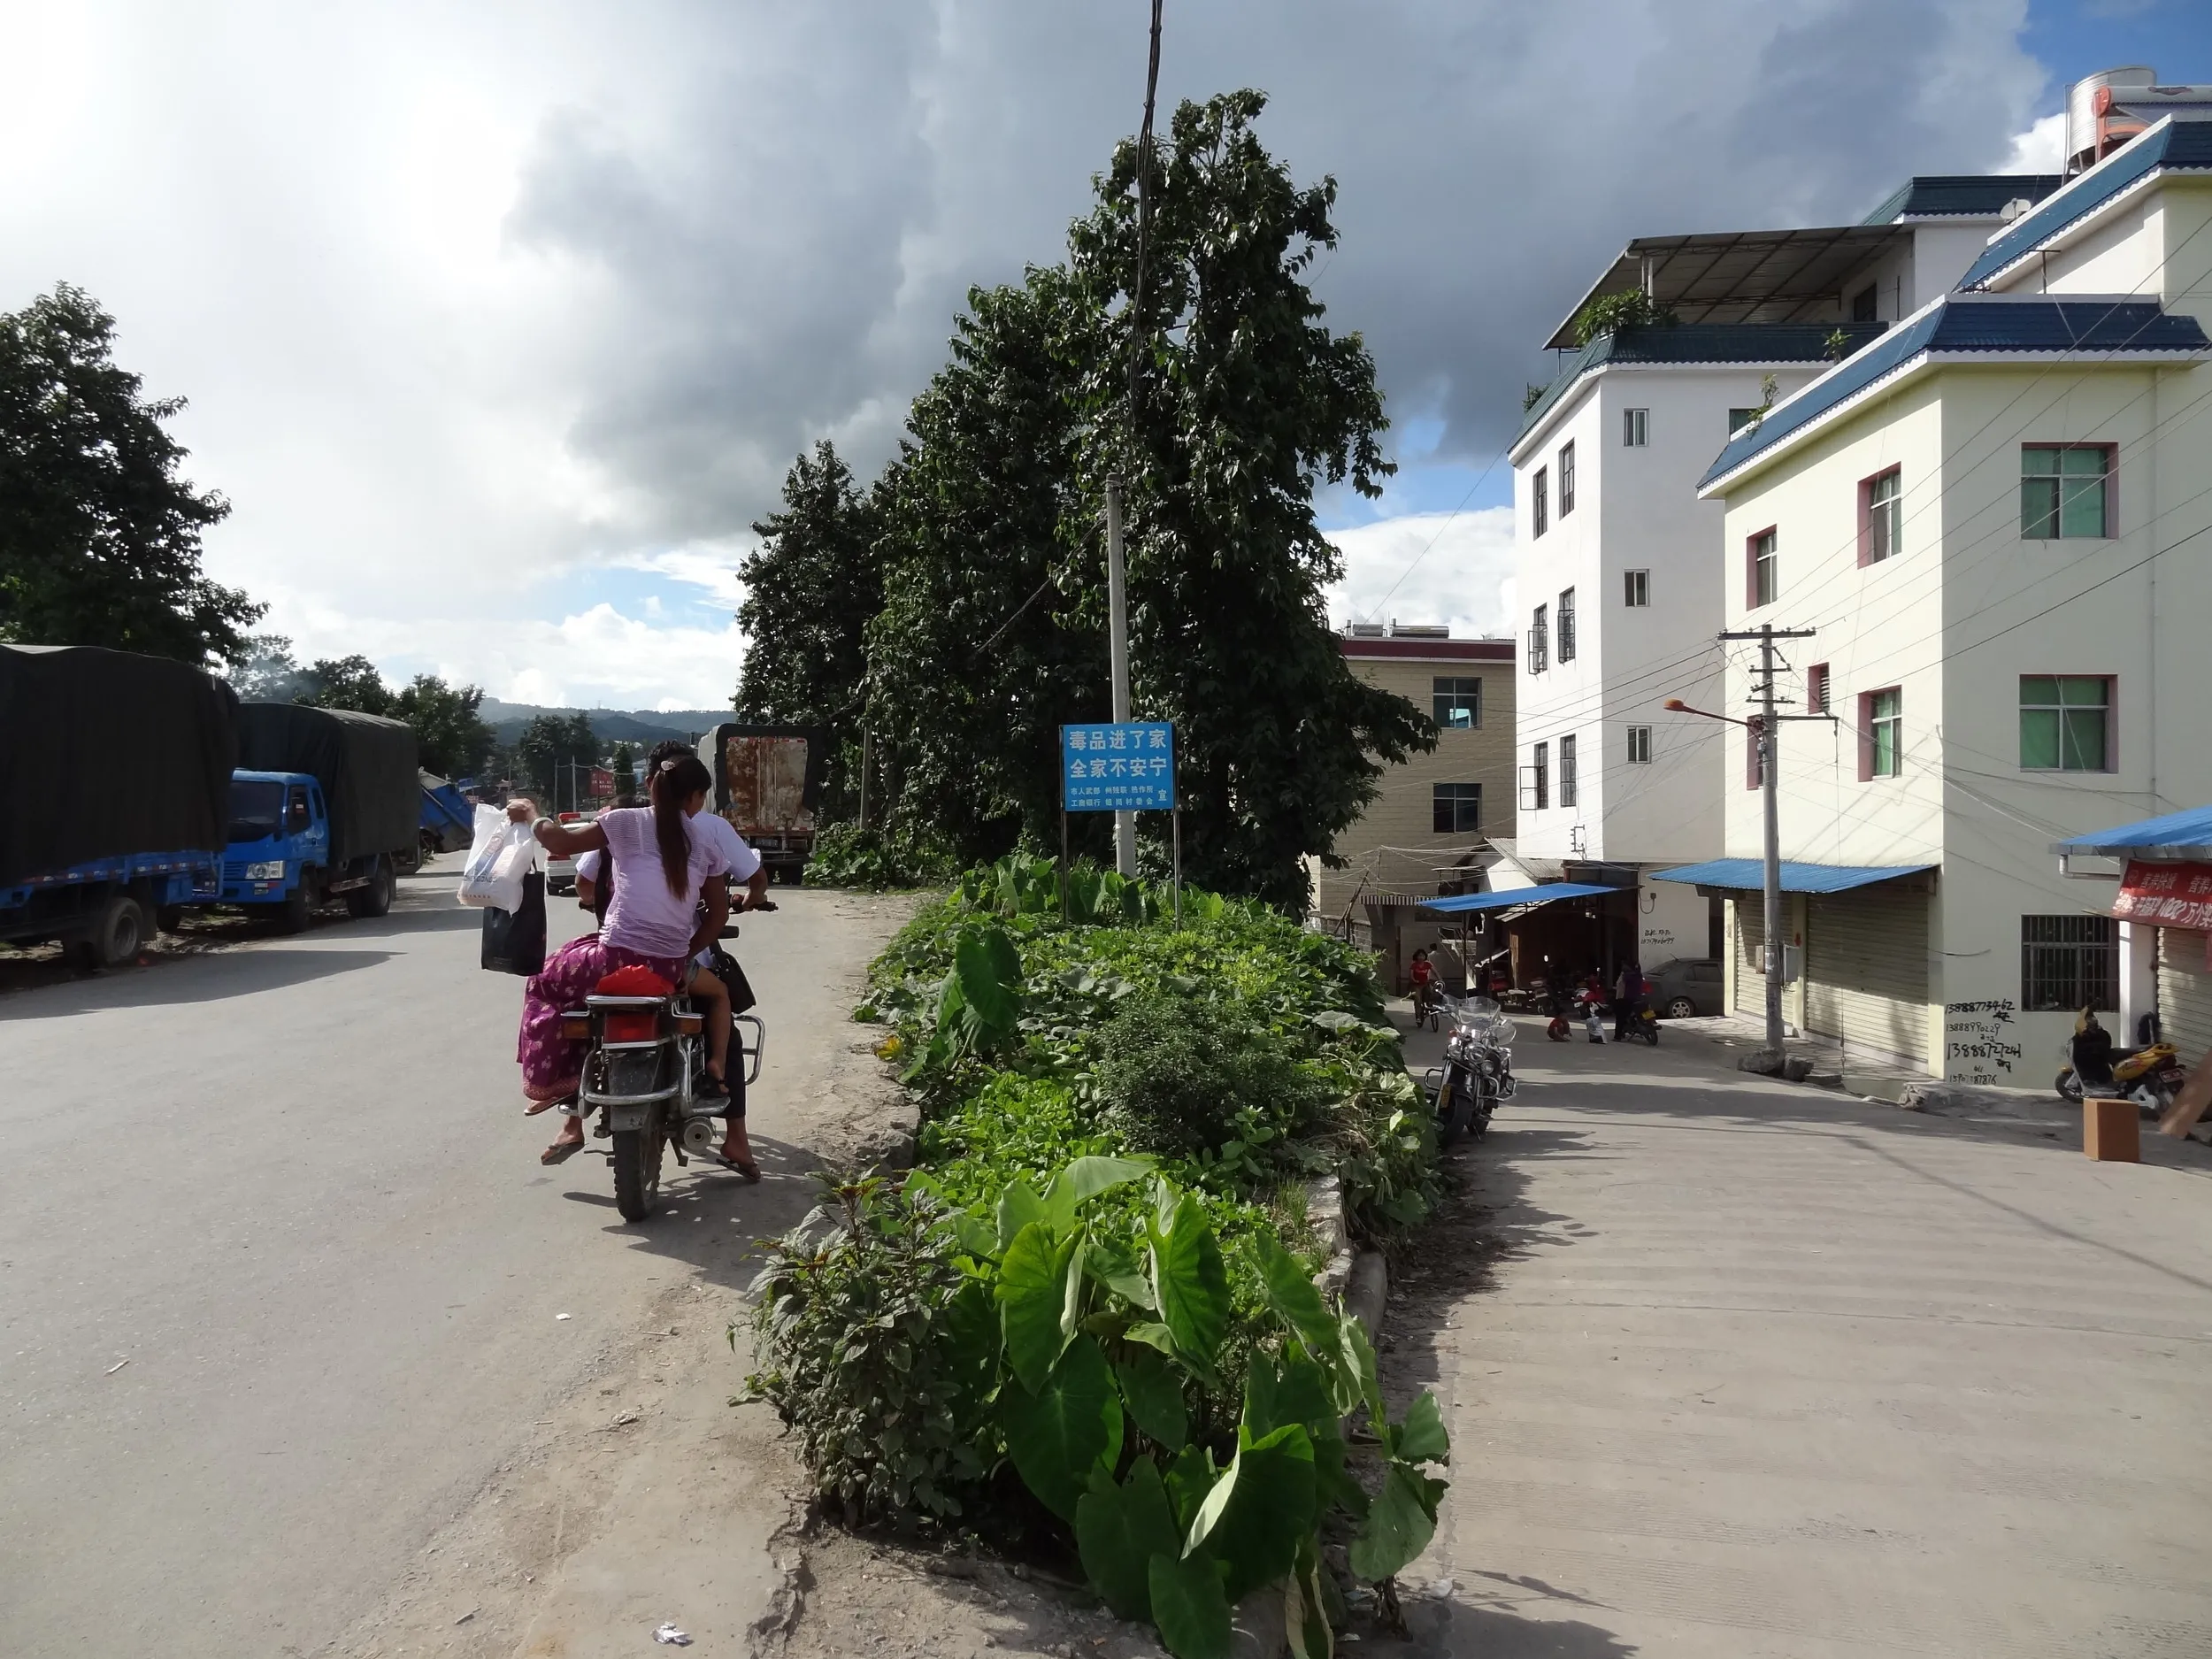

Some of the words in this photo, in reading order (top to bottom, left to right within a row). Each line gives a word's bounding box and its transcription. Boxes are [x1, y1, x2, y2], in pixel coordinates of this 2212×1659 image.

[1069, 729, 1166, 750] 毒品进了家
[1070, 757, 1167, 779] 全家不安宁
[1071, 798, 1101, 807] 工商银行
[1158, 789, 1167, 802] 宣
[1945, 998, 2016, 1014] 13888773462
[1946, 1021, 2001, 1036] 13888990229
[1947, 1042, 2022, 1061] 13888727241
